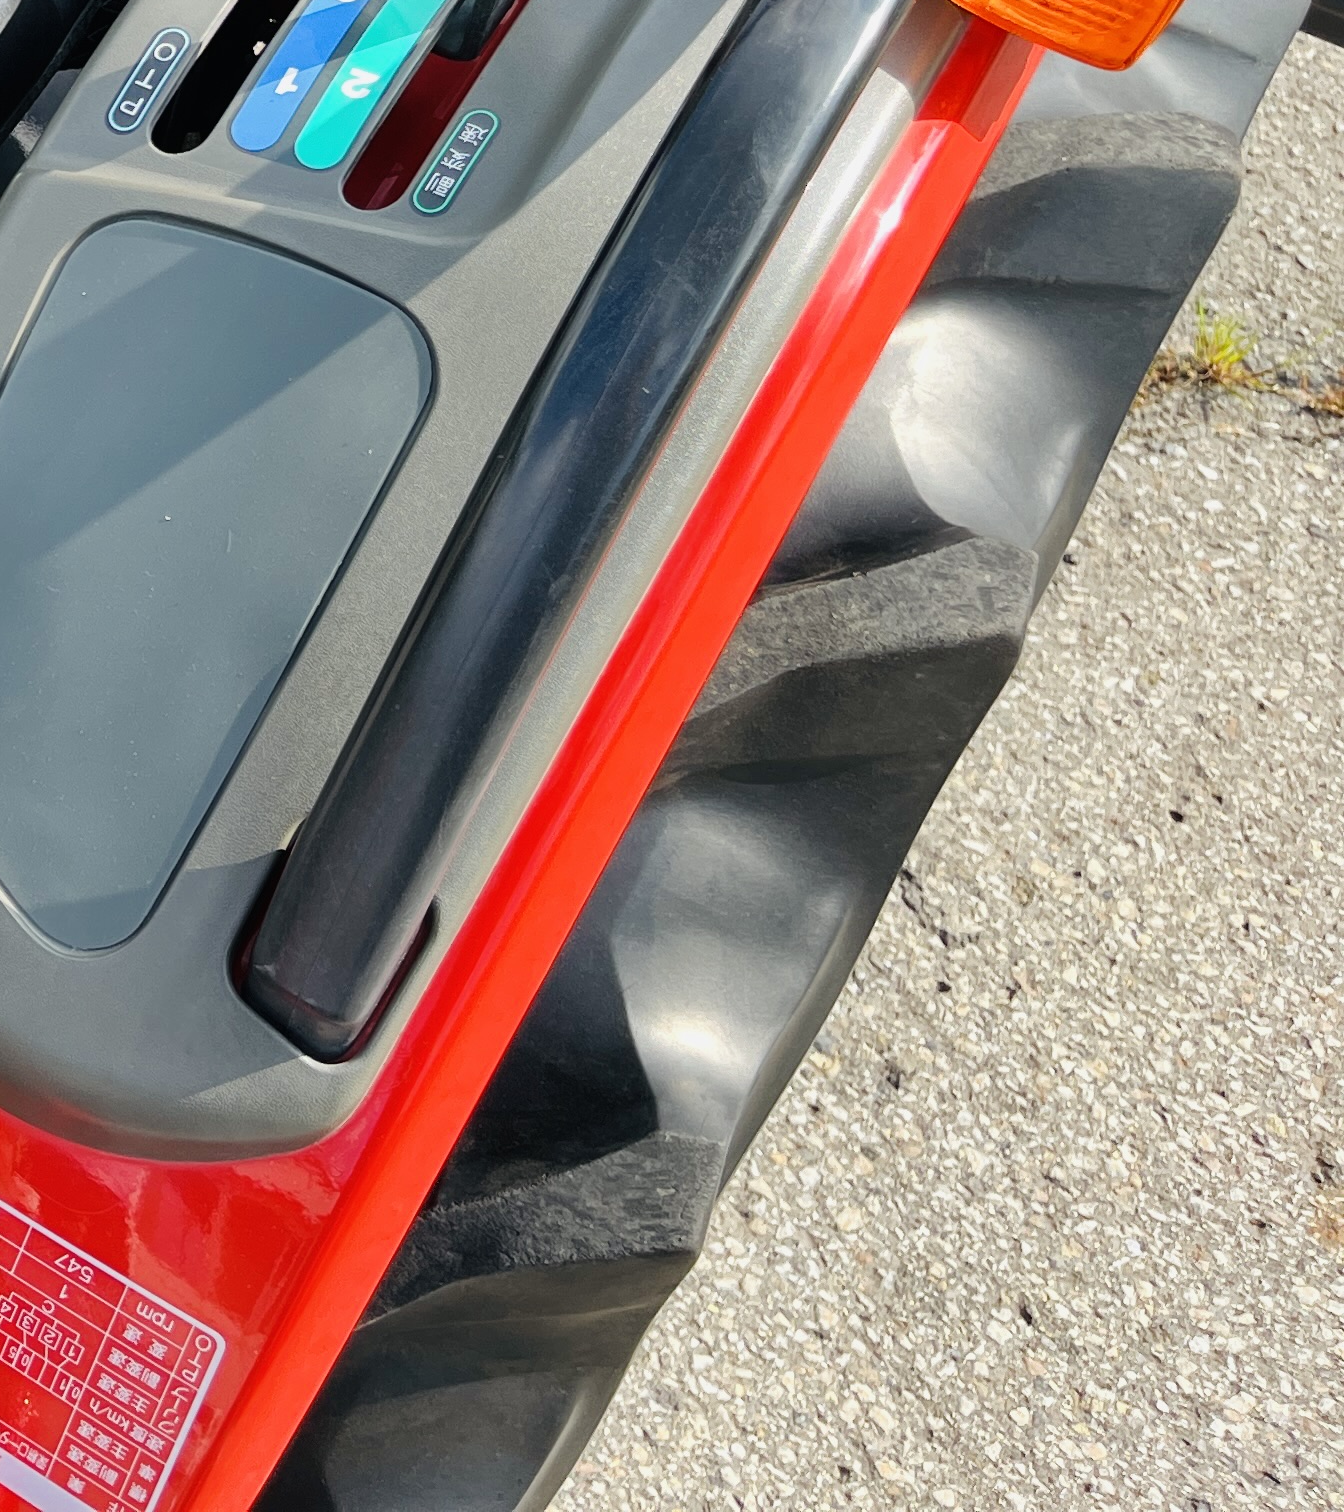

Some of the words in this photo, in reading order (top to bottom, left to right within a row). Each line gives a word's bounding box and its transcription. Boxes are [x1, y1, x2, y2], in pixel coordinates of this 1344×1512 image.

[118, 41, 179, 117] PTO
[274, 66, 300, 95] 1
[339, 68, 382, 100] 2
[53, 1253, 95, 1284] 547
[41, 1299, 56, 1314] C
[59, 1284, 69, 1299] 1
[136, 1301, 175, 1332] rpm
[181, 1334, 212, 1383] PTO
